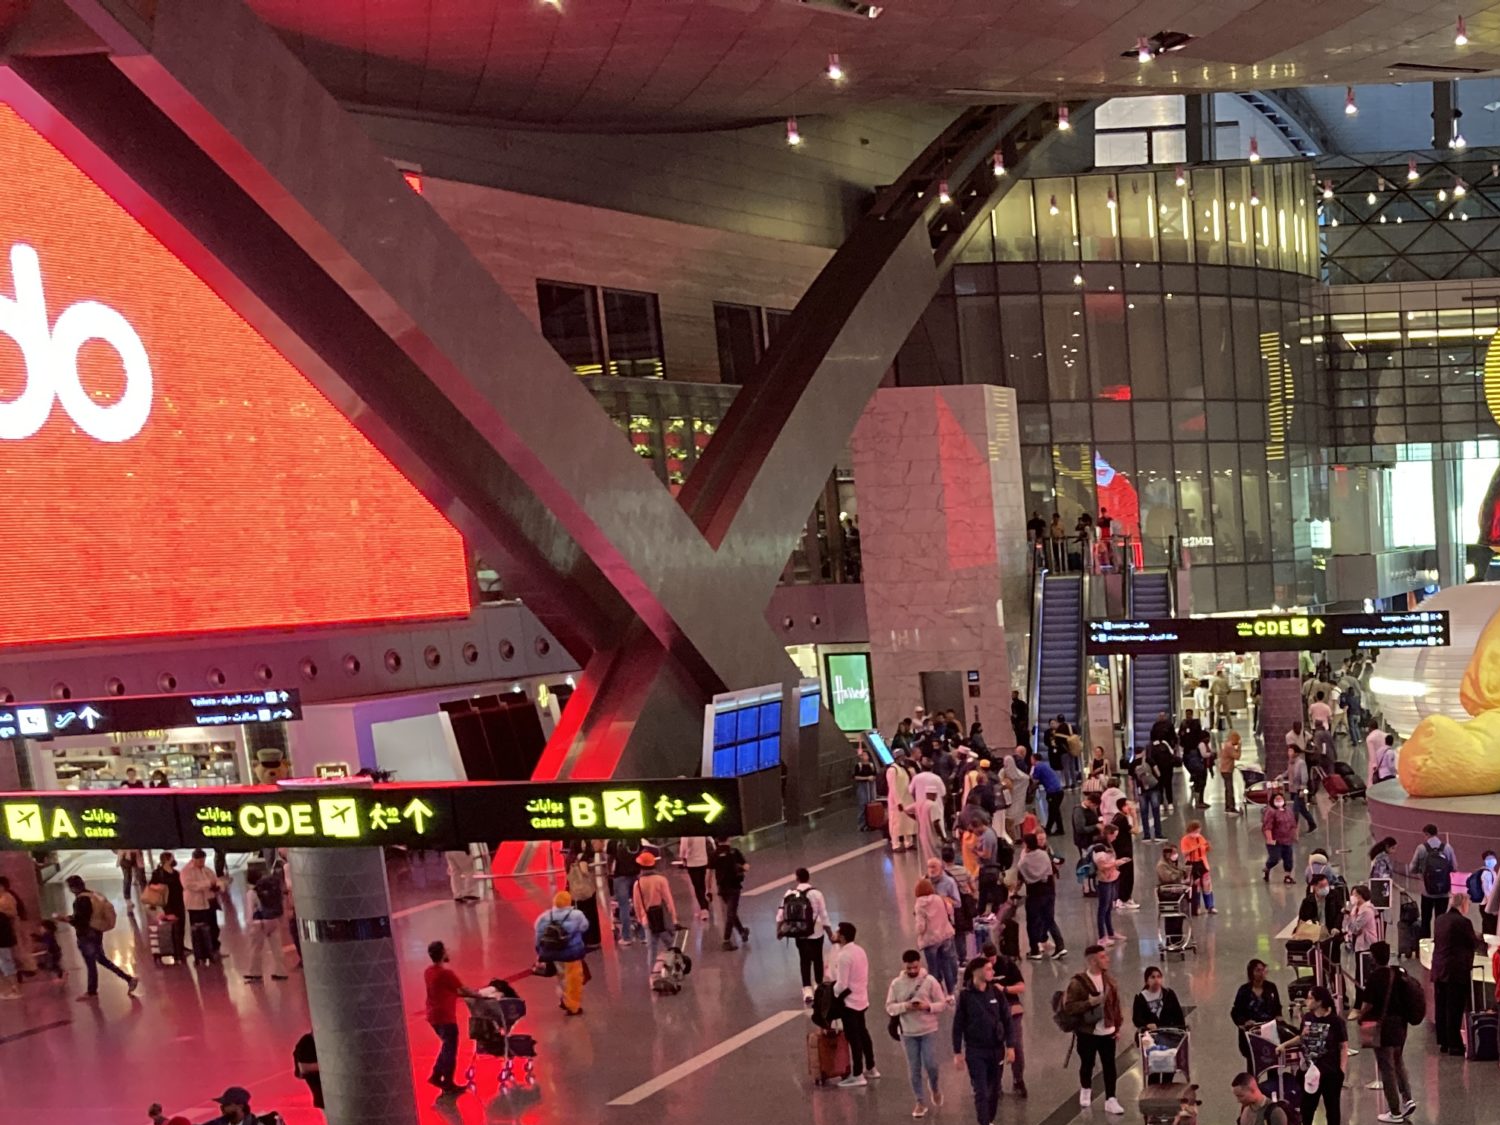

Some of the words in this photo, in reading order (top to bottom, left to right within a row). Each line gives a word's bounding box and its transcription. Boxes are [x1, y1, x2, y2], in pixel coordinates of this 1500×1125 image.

[1254, 620, 1290, 636] CDE
[196, 805, 232, 823] بوابات
[386, 807, 398, 817] 10
[526, 799, 564, 814] بوابات
[570, 797, 598, 828] B
[51, 808, 78, 839] A
[81, 807, 117, 824] بوابات
[239, 804, 316, 837] CDE
[531, 817, 565, 829] Gates
[85, 826, 117, 839] Gates
[203, 824, 234, 837] Gates
